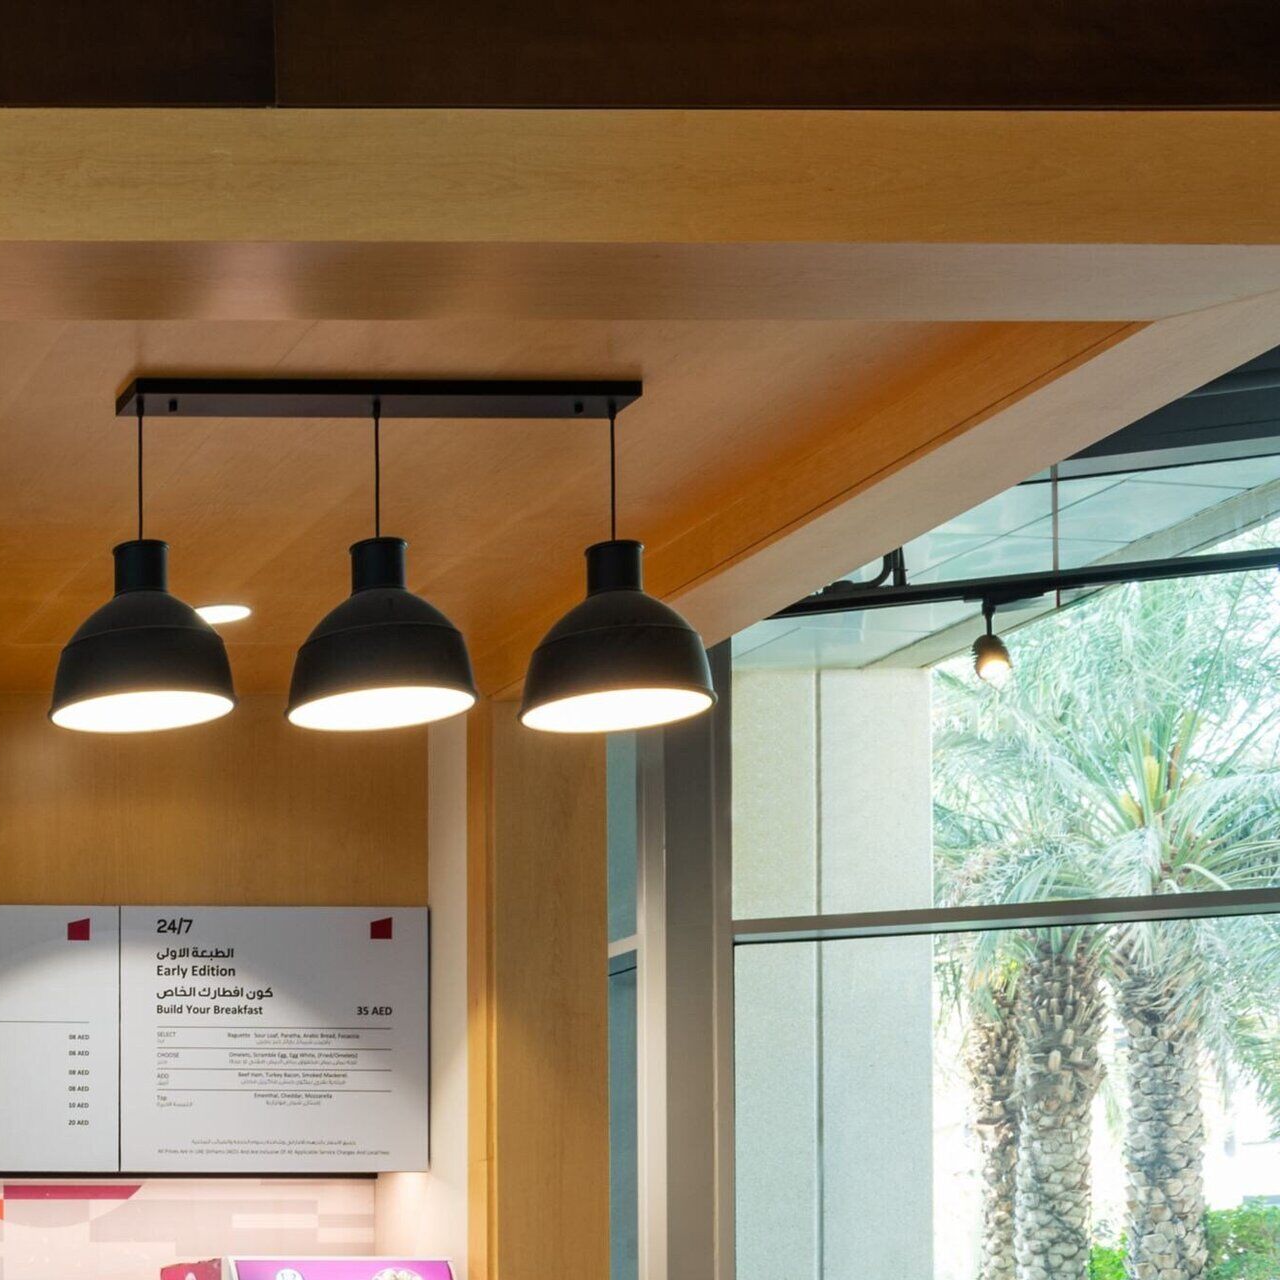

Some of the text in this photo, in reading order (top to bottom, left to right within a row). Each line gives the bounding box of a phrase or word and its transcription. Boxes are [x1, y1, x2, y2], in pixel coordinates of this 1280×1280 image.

[156, 917, 194, 935] 24/7
[191, 946, 234, 961] الطبعة
[156, 964, 236, 979] Early Edition
[156, 986, 274, 1000] كون افطارك الخاص
[156, 1004, 264, 1015] Build Your Breakfast
[356, 1005, 394, 1016] 35 AED
